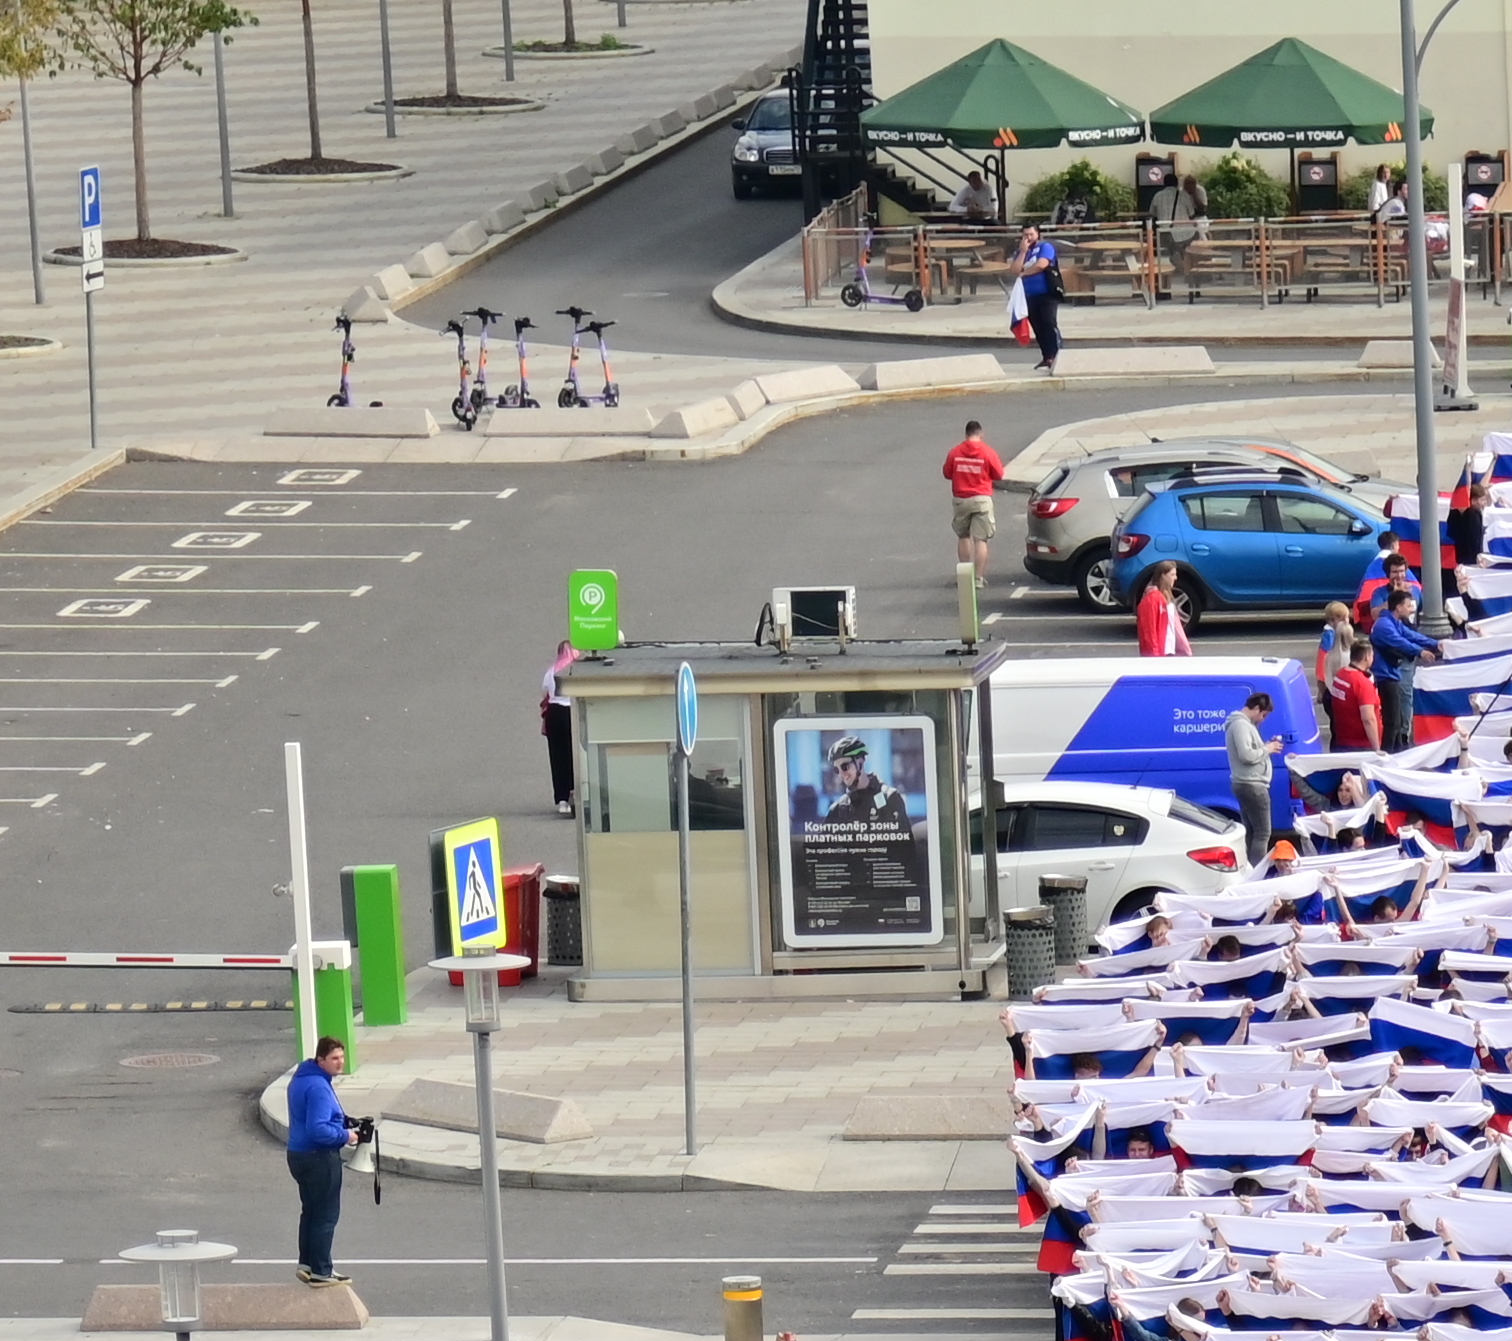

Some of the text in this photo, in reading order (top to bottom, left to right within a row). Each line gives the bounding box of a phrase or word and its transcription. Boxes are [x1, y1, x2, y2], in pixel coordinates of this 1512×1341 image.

[867, 130, 899, 140] ВКУСНО
[915, 132, 944, 142] ТОЧКА
[1068, 129, 1101, 141] ВКУСНО
[1115, 126, 1141, 138] ТОЧКА
[1240, 131, 1286, 141] ВКУСНО
[1295, 131, 1304, 141] И
[1306, 130, 1345, 141] ТОЧКА
[1173, 708, 1226, 719] Это тоже
[1173, 723, 1226, 734] каршери
[804, 821, 899, 833] Контролёр зоны
[805, 832, 910, 843] платных парковок
